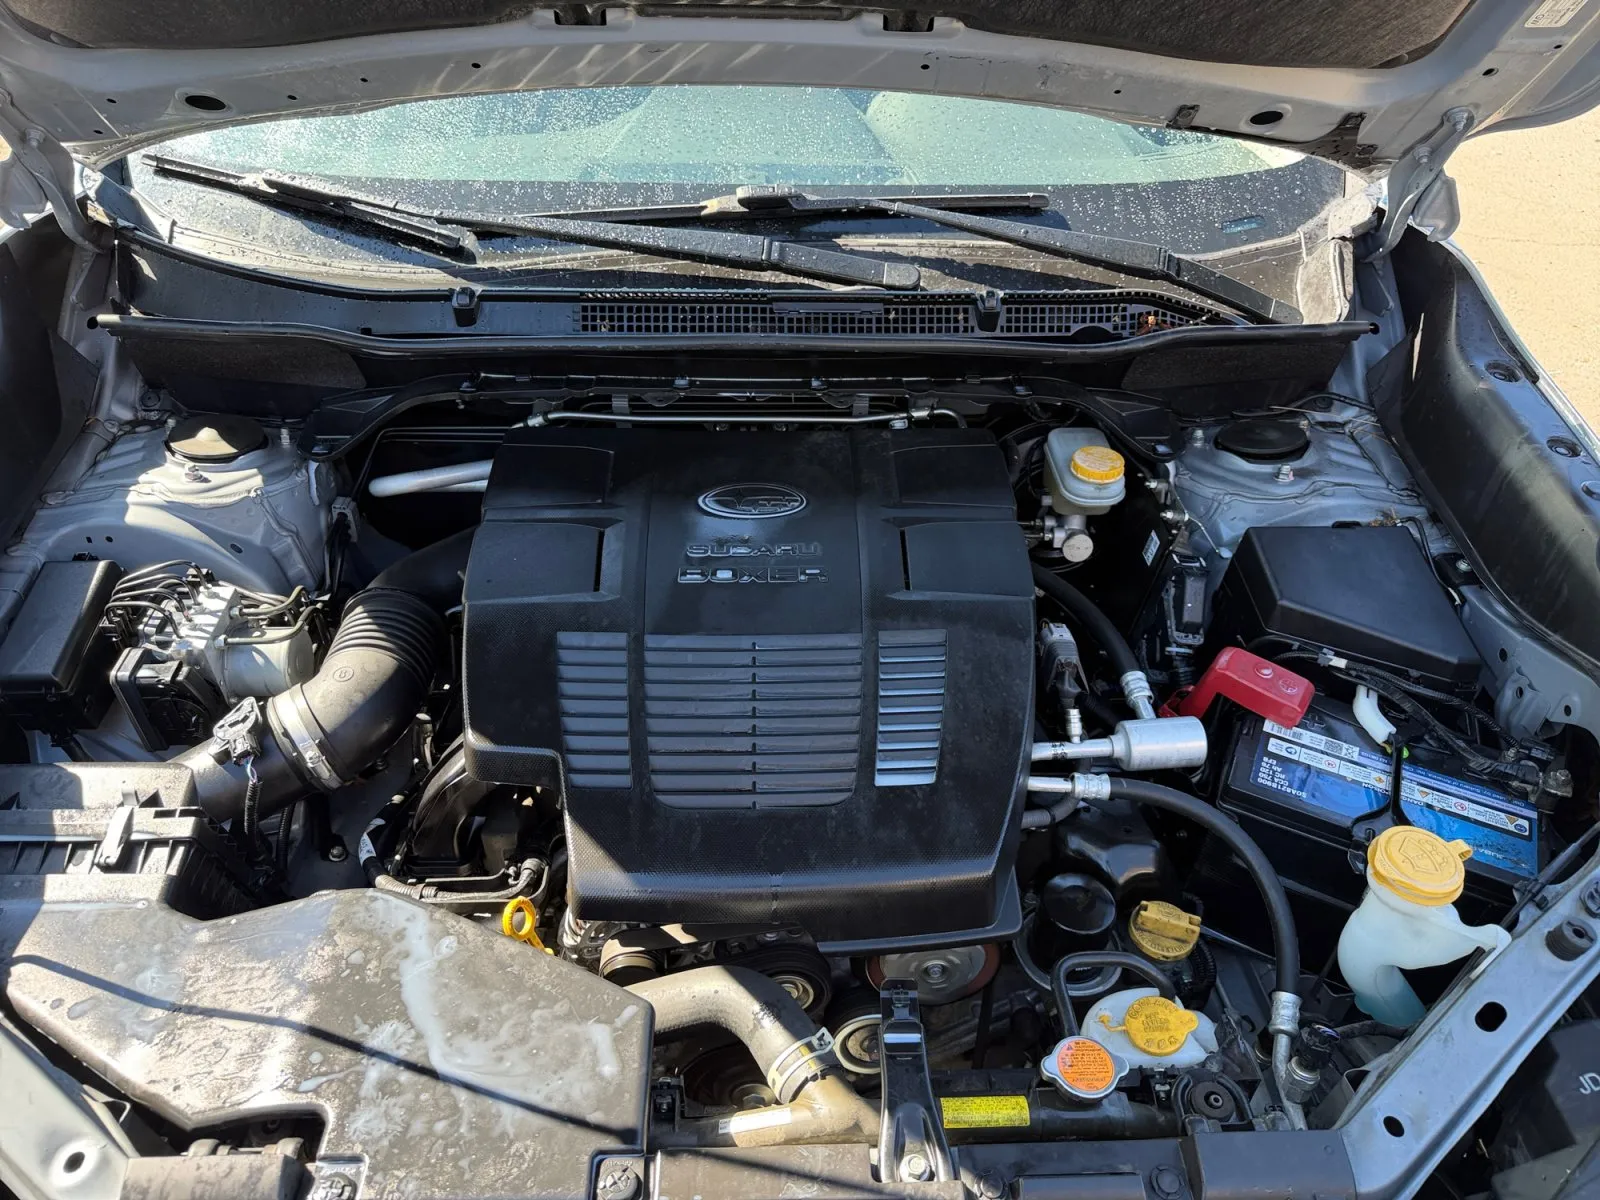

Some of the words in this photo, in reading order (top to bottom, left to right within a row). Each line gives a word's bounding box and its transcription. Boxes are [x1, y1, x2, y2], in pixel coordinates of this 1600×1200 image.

[686, 543, 823, 558] SUBARU
[677, 566, 829, 583] BOXER
[1259, 772, 1272, 781] 750
[1275, 772, 1286, 780] RC
[1274, 777, 1289, 786] CCA
